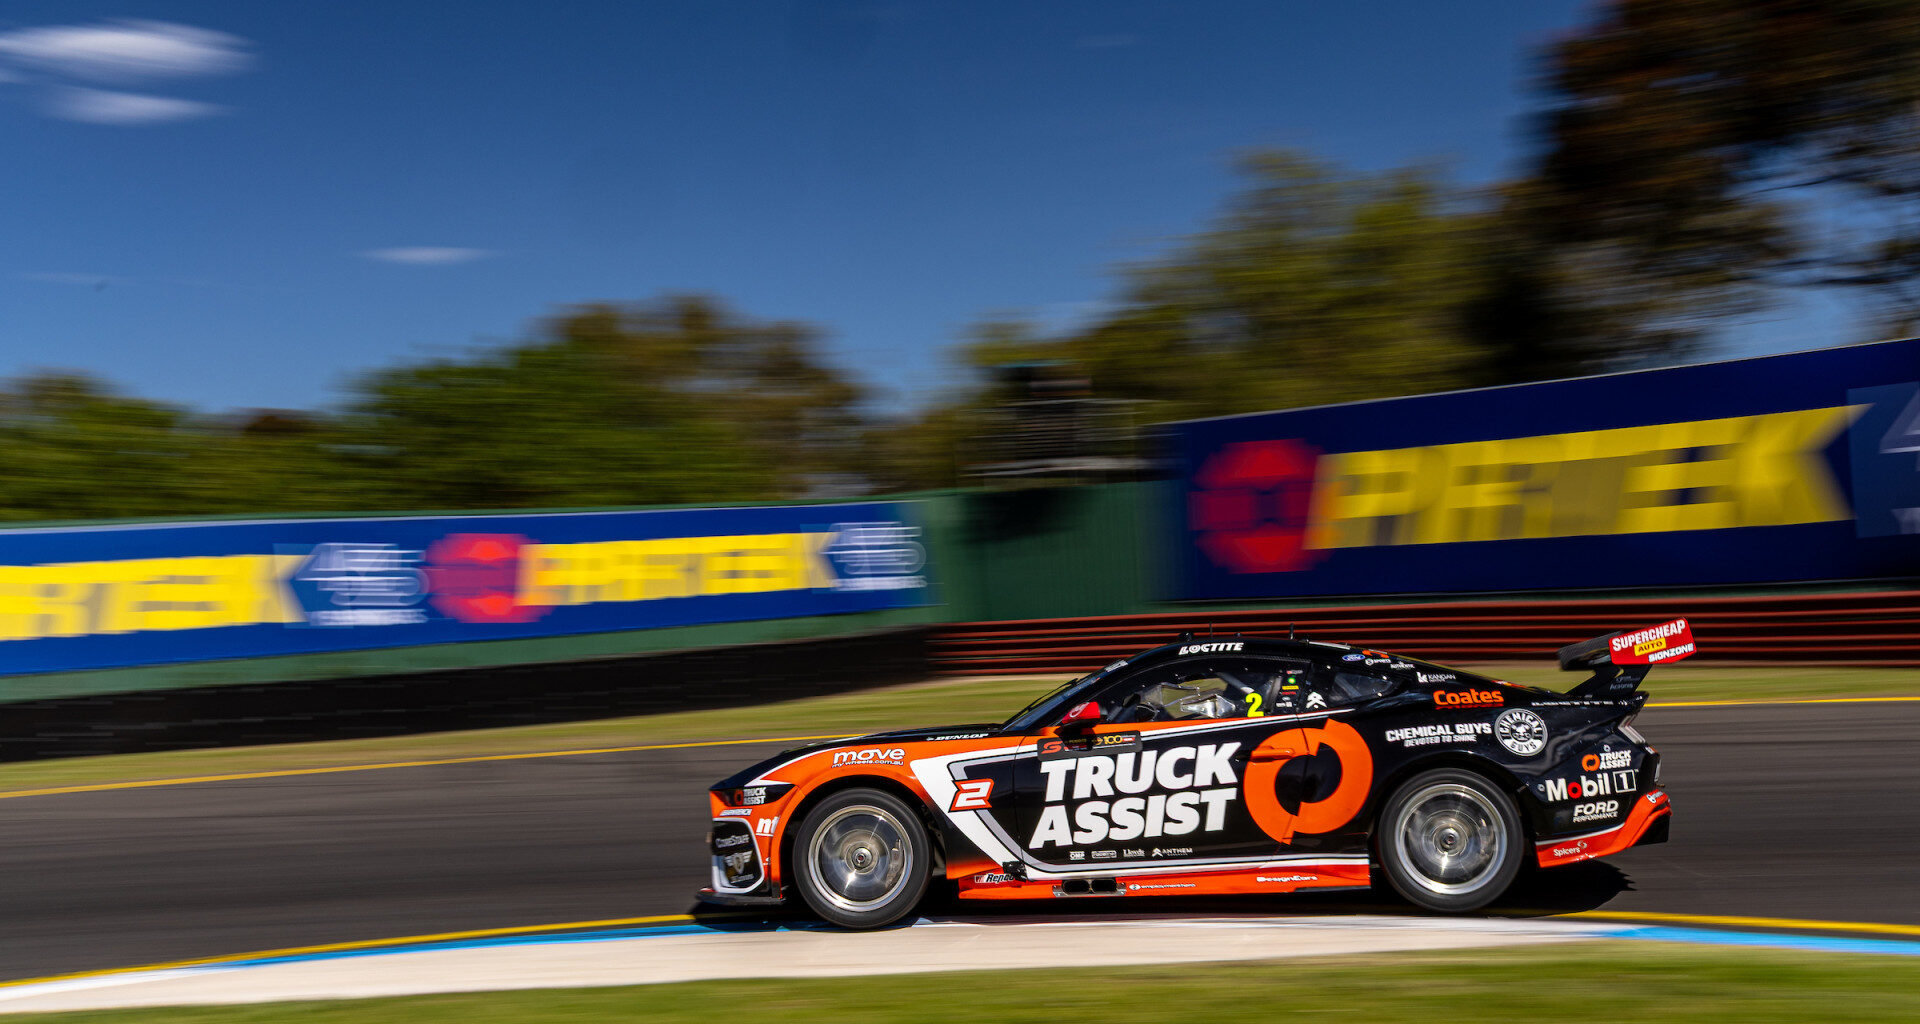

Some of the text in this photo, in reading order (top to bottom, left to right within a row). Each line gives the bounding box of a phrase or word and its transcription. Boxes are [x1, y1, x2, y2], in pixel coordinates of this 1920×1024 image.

[1612, 619, 1686, 651] SUPERCHEAP
[1178, 642, 1244, 656] LOCTITE
[1638, 641, 1663, 653] AUTO
[1246, 693, 1264, 717] 2
[1433, 688, 1504, 706] Coates
[1499, 712, 1543, 734] CHEMICAL
[1385, 722, 1492, 742] CHEMICAL GUYS
[1404, 735, 1440, 748] DEVOTED
[1441, 735, 1452, 744] TO
[1510, 741, 1537, 752] GUYS
[833, 748, 905, 764] move
[1600, 750, 1631, 760] TRUCK
[1039, 742, 1241, 802] TRUCK
[1599, 759, 1631, 770] ASSIST
[952, 780, 993, 810] 2
[1545, 773, 1612, 801] Mobil
[1574, 800, 1619, 816] FORD
[1028, 788, 1237, 849] ASSIST
[1553, 846, 1581, 857] Spicers
